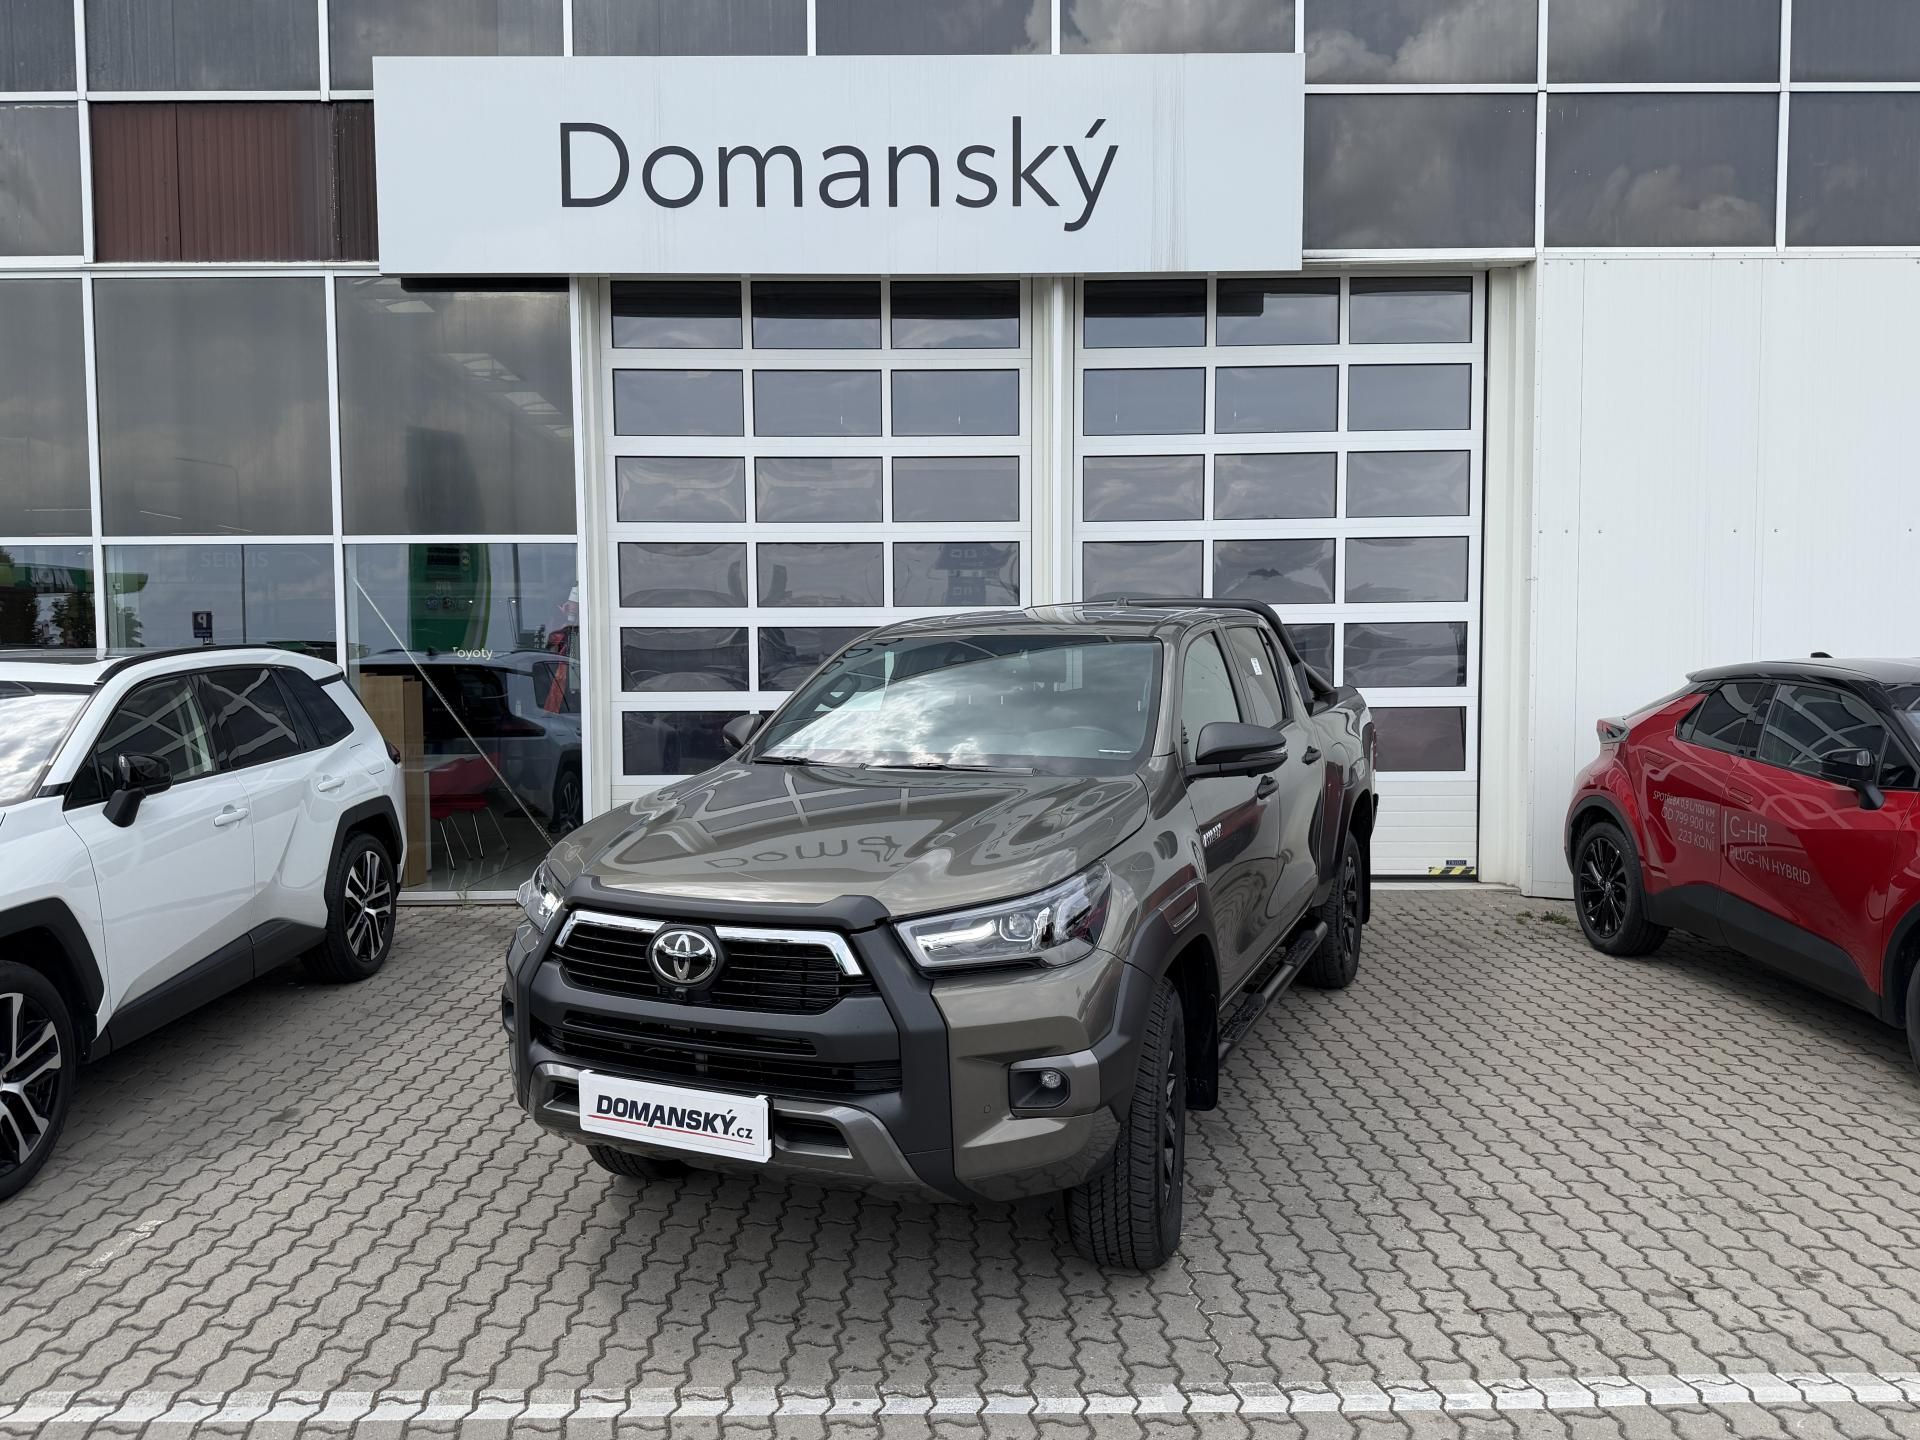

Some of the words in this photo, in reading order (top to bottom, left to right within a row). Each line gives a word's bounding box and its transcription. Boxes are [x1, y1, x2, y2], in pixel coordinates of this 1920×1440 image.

[560, 116, 1119, 232] Domanský
[1661, 806, 1673, 820] OD
[1705, 807, 1715, 817] KM
[1678, 828, 1692, 844] 223
[1729, 815, 1768, 847] C-HR
[1729, 844, 1770, 872] PLUG-IN
[1772, 858, 1811, 885] HYBRID
